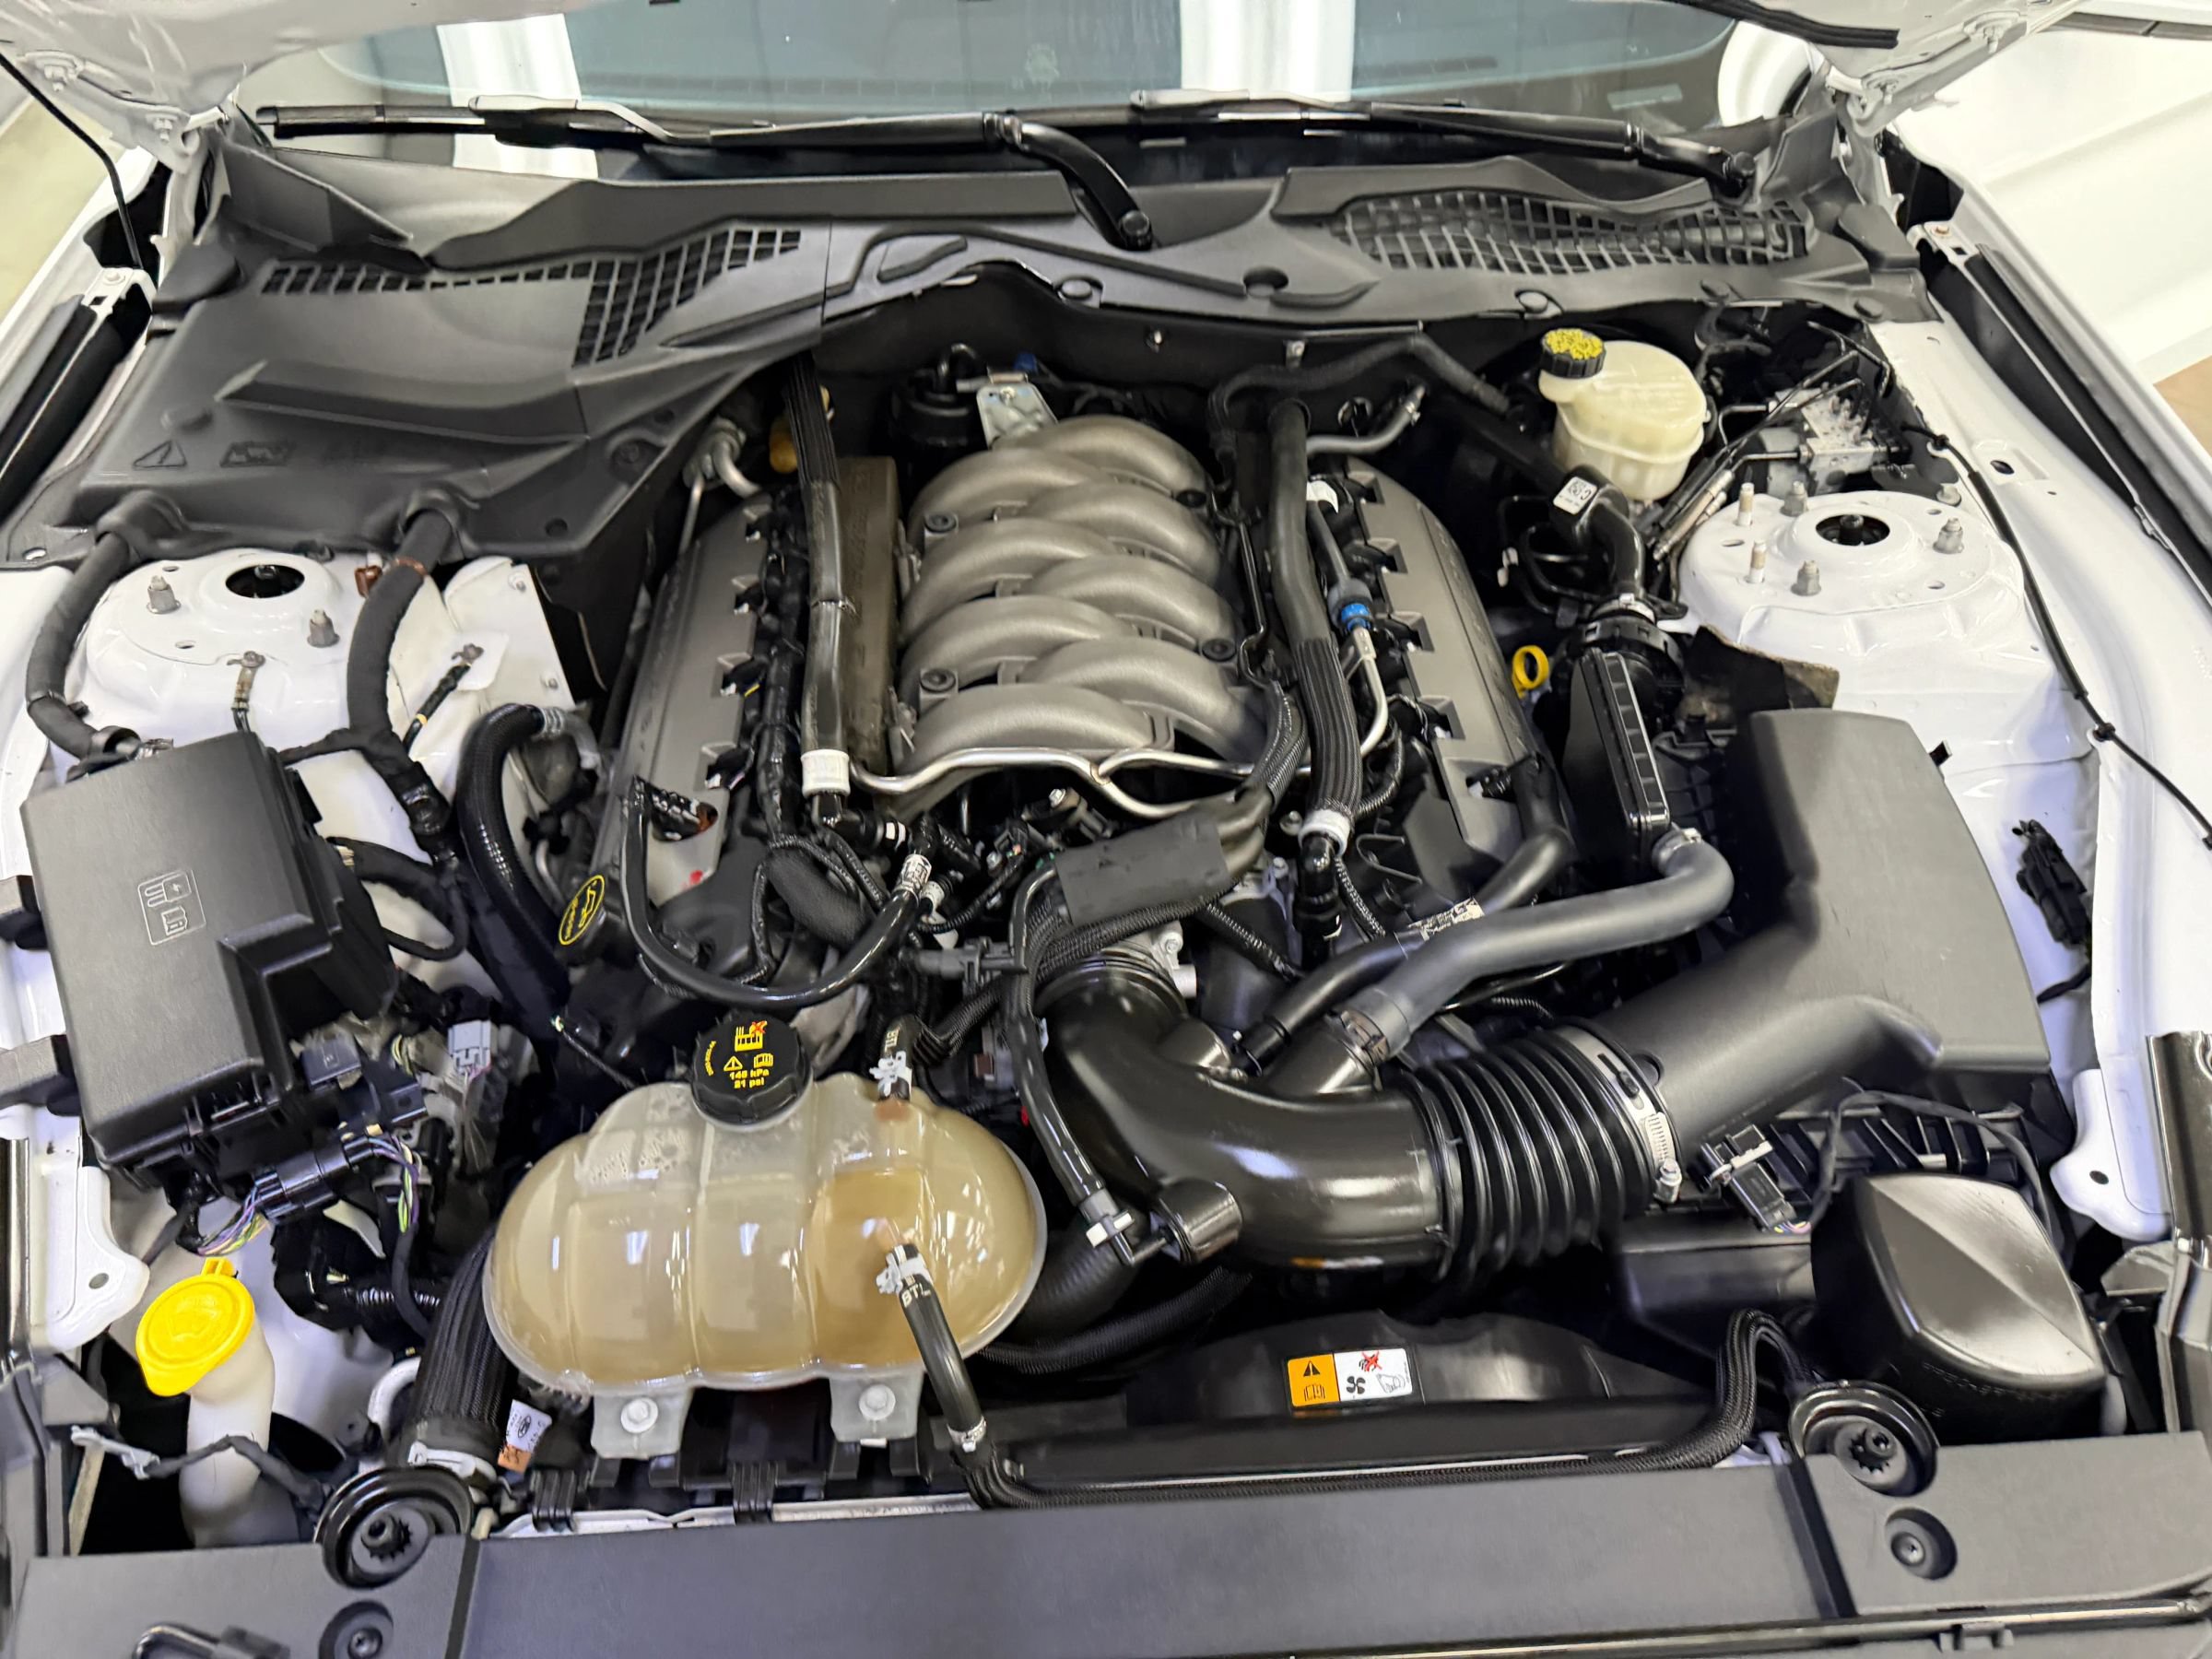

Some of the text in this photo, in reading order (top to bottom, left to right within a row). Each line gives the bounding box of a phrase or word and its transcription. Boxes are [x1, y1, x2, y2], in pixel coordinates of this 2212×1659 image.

[750, 1068, 770, 1078] kPa
[749, 1077, 765, 1088] psi
[901, 1282, 931, 1308] BTL
